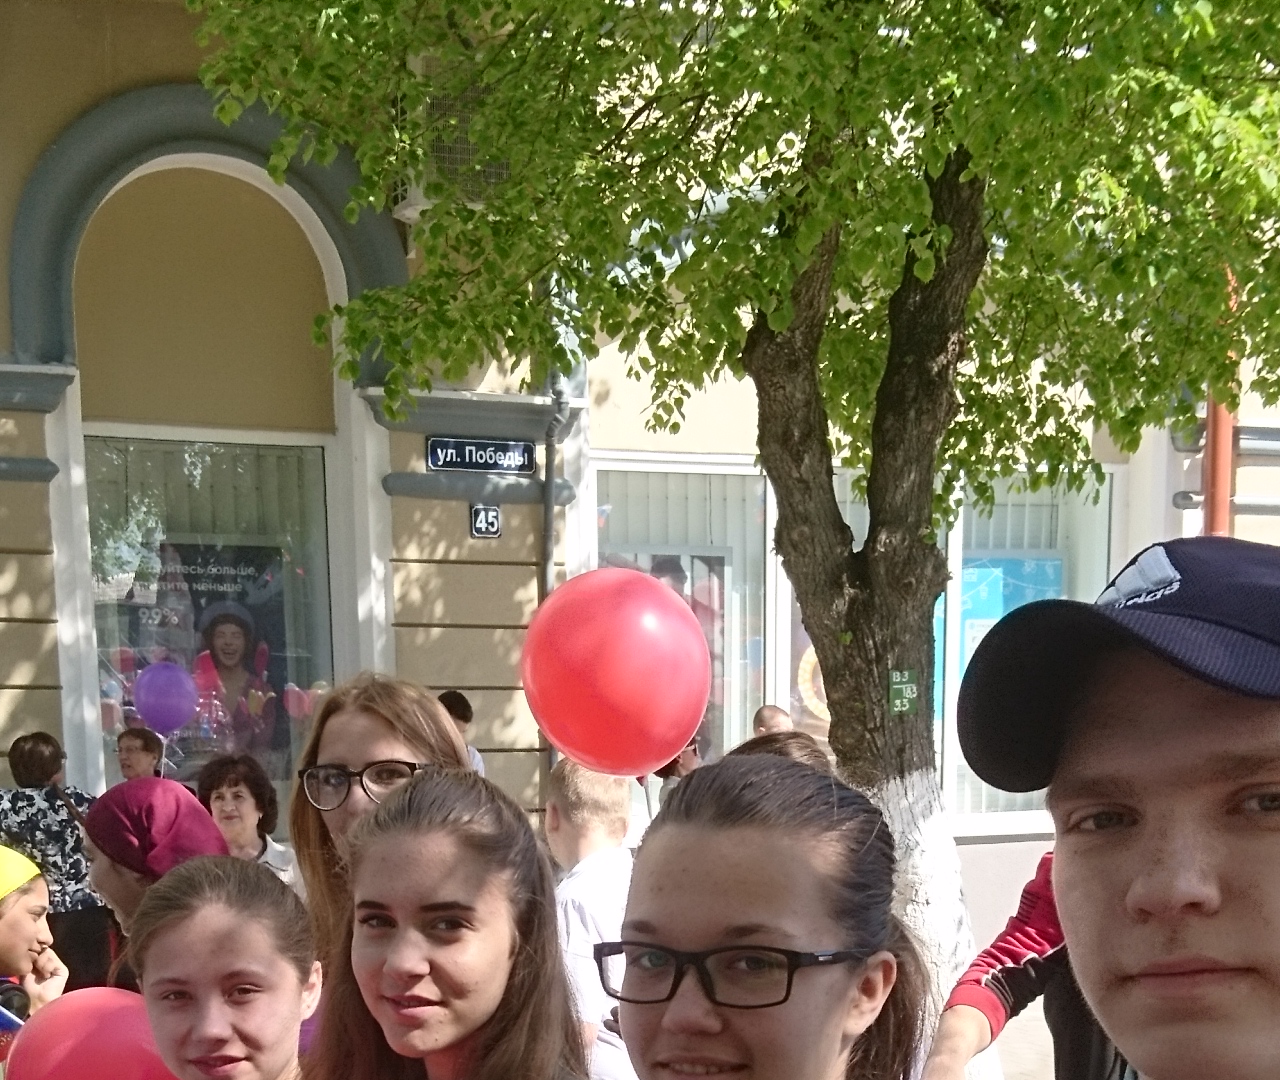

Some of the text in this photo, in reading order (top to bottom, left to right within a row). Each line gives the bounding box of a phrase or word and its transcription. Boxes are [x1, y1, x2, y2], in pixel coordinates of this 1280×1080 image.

[436, 446, 528, 468] ул. Победы
[475, 510, 498, 532] 45
